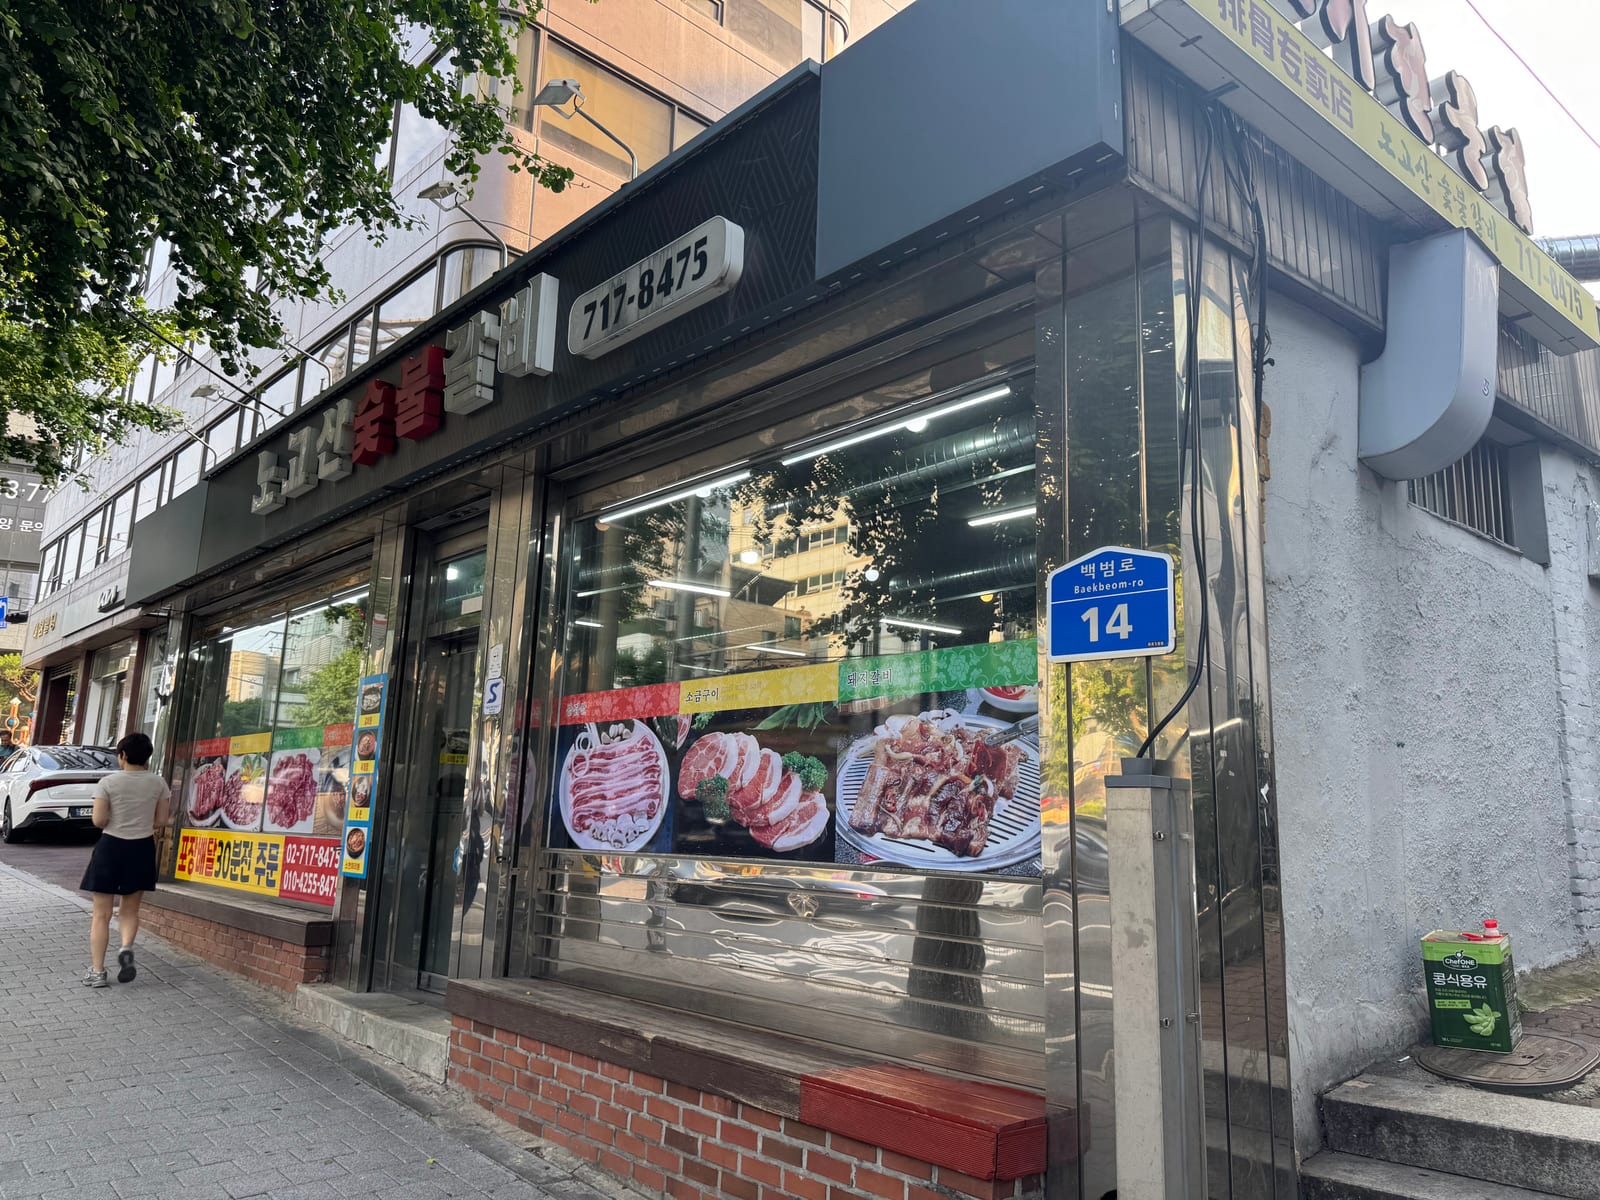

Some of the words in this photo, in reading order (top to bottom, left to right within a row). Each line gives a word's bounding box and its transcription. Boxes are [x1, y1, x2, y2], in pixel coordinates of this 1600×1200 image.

[583, 236, 708, 340] 717-8475
[1514, 235, 1583, 321] 717-8475
[1080, 558, 1136, 579] 백범로
[1074, 579, 1144, 594] Baekbeom-ro
[1080, 603, 1133, 642] 14
[847, 668, 892, 688] 돼지갈비
[685, 688, 719, 702] 소금구이
[255, 842, 280, 887] 주문
[1432, 972, 1488, 989] 콩식용유
